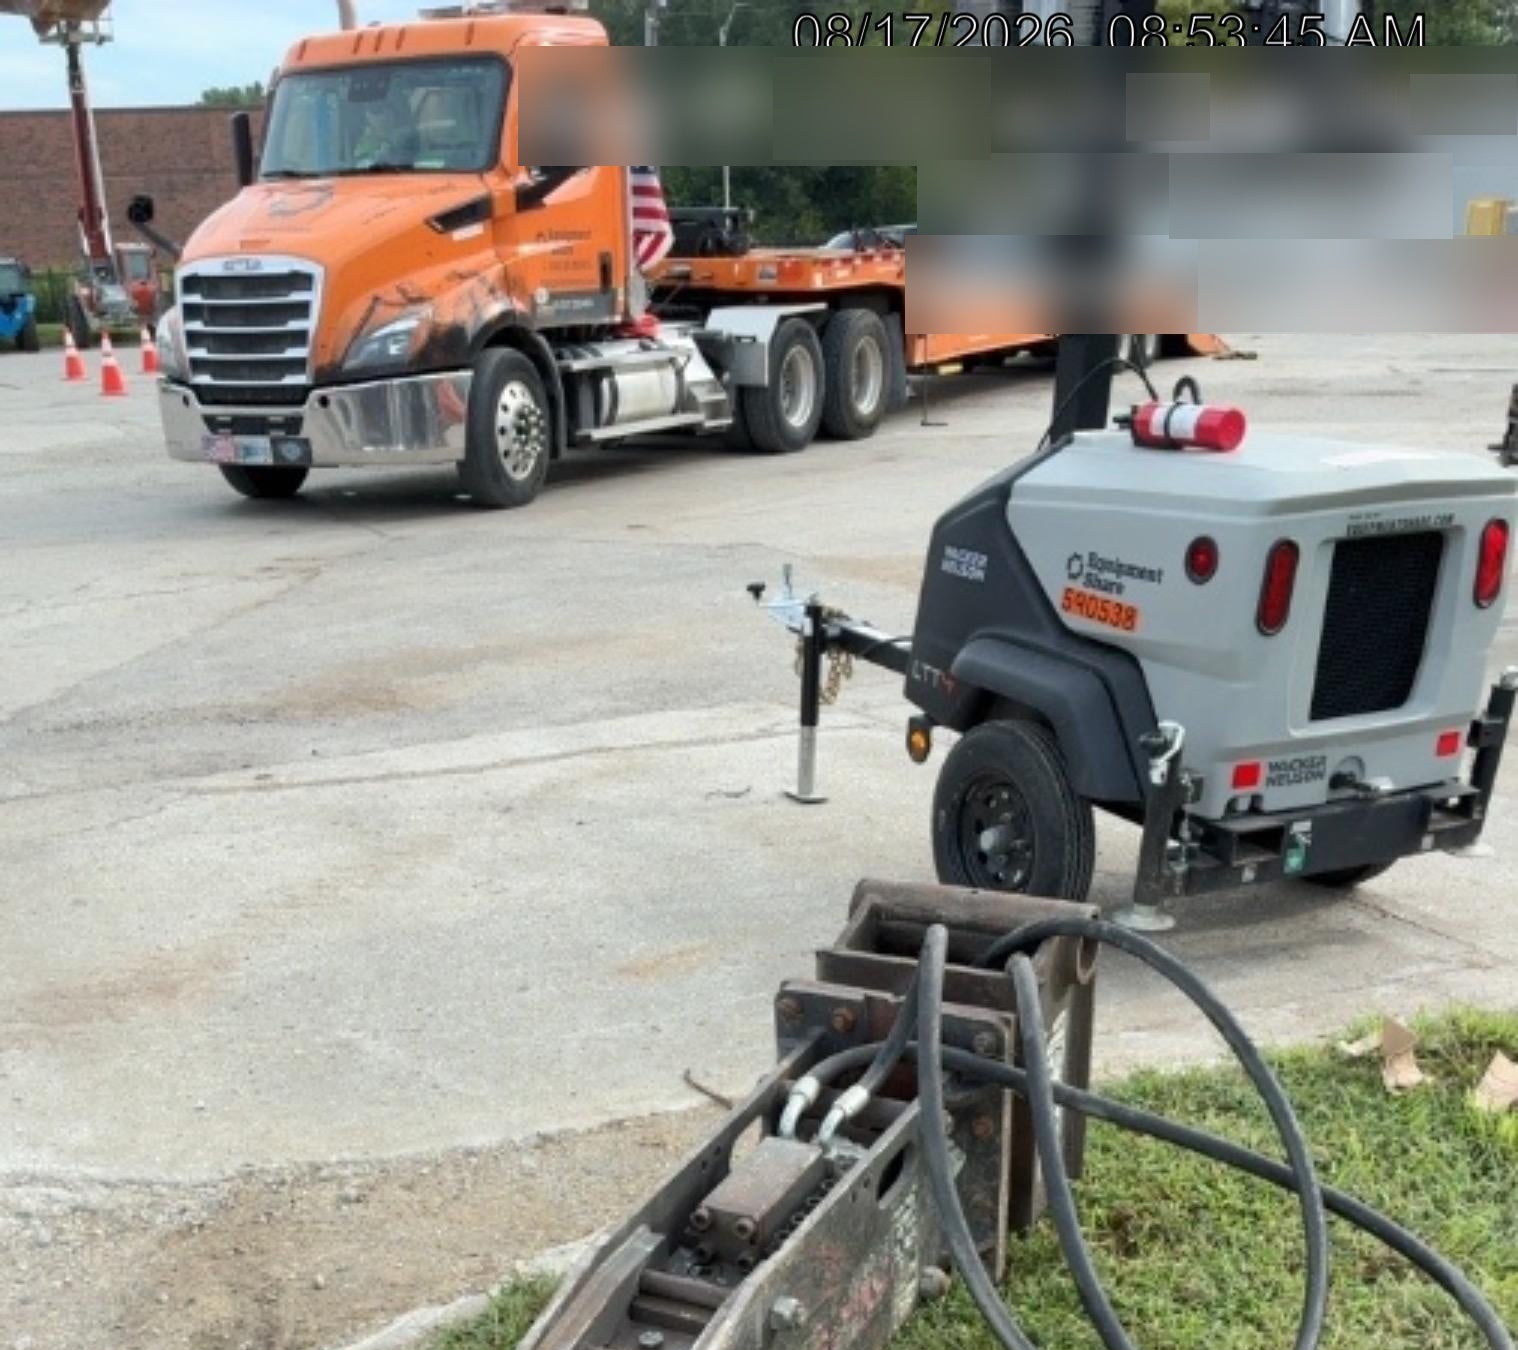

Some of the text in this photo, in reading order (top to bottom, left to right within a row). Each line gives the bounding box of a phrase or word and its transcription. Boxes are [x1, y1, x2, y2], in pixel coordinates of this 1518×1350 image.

[1087, 551, 1164, 585] Equipment
[1083, 571, 1125, 595] Share
[1268, 755, 1327, 772] WACKER
[1265, 769, 1325, 789] NEUSON
